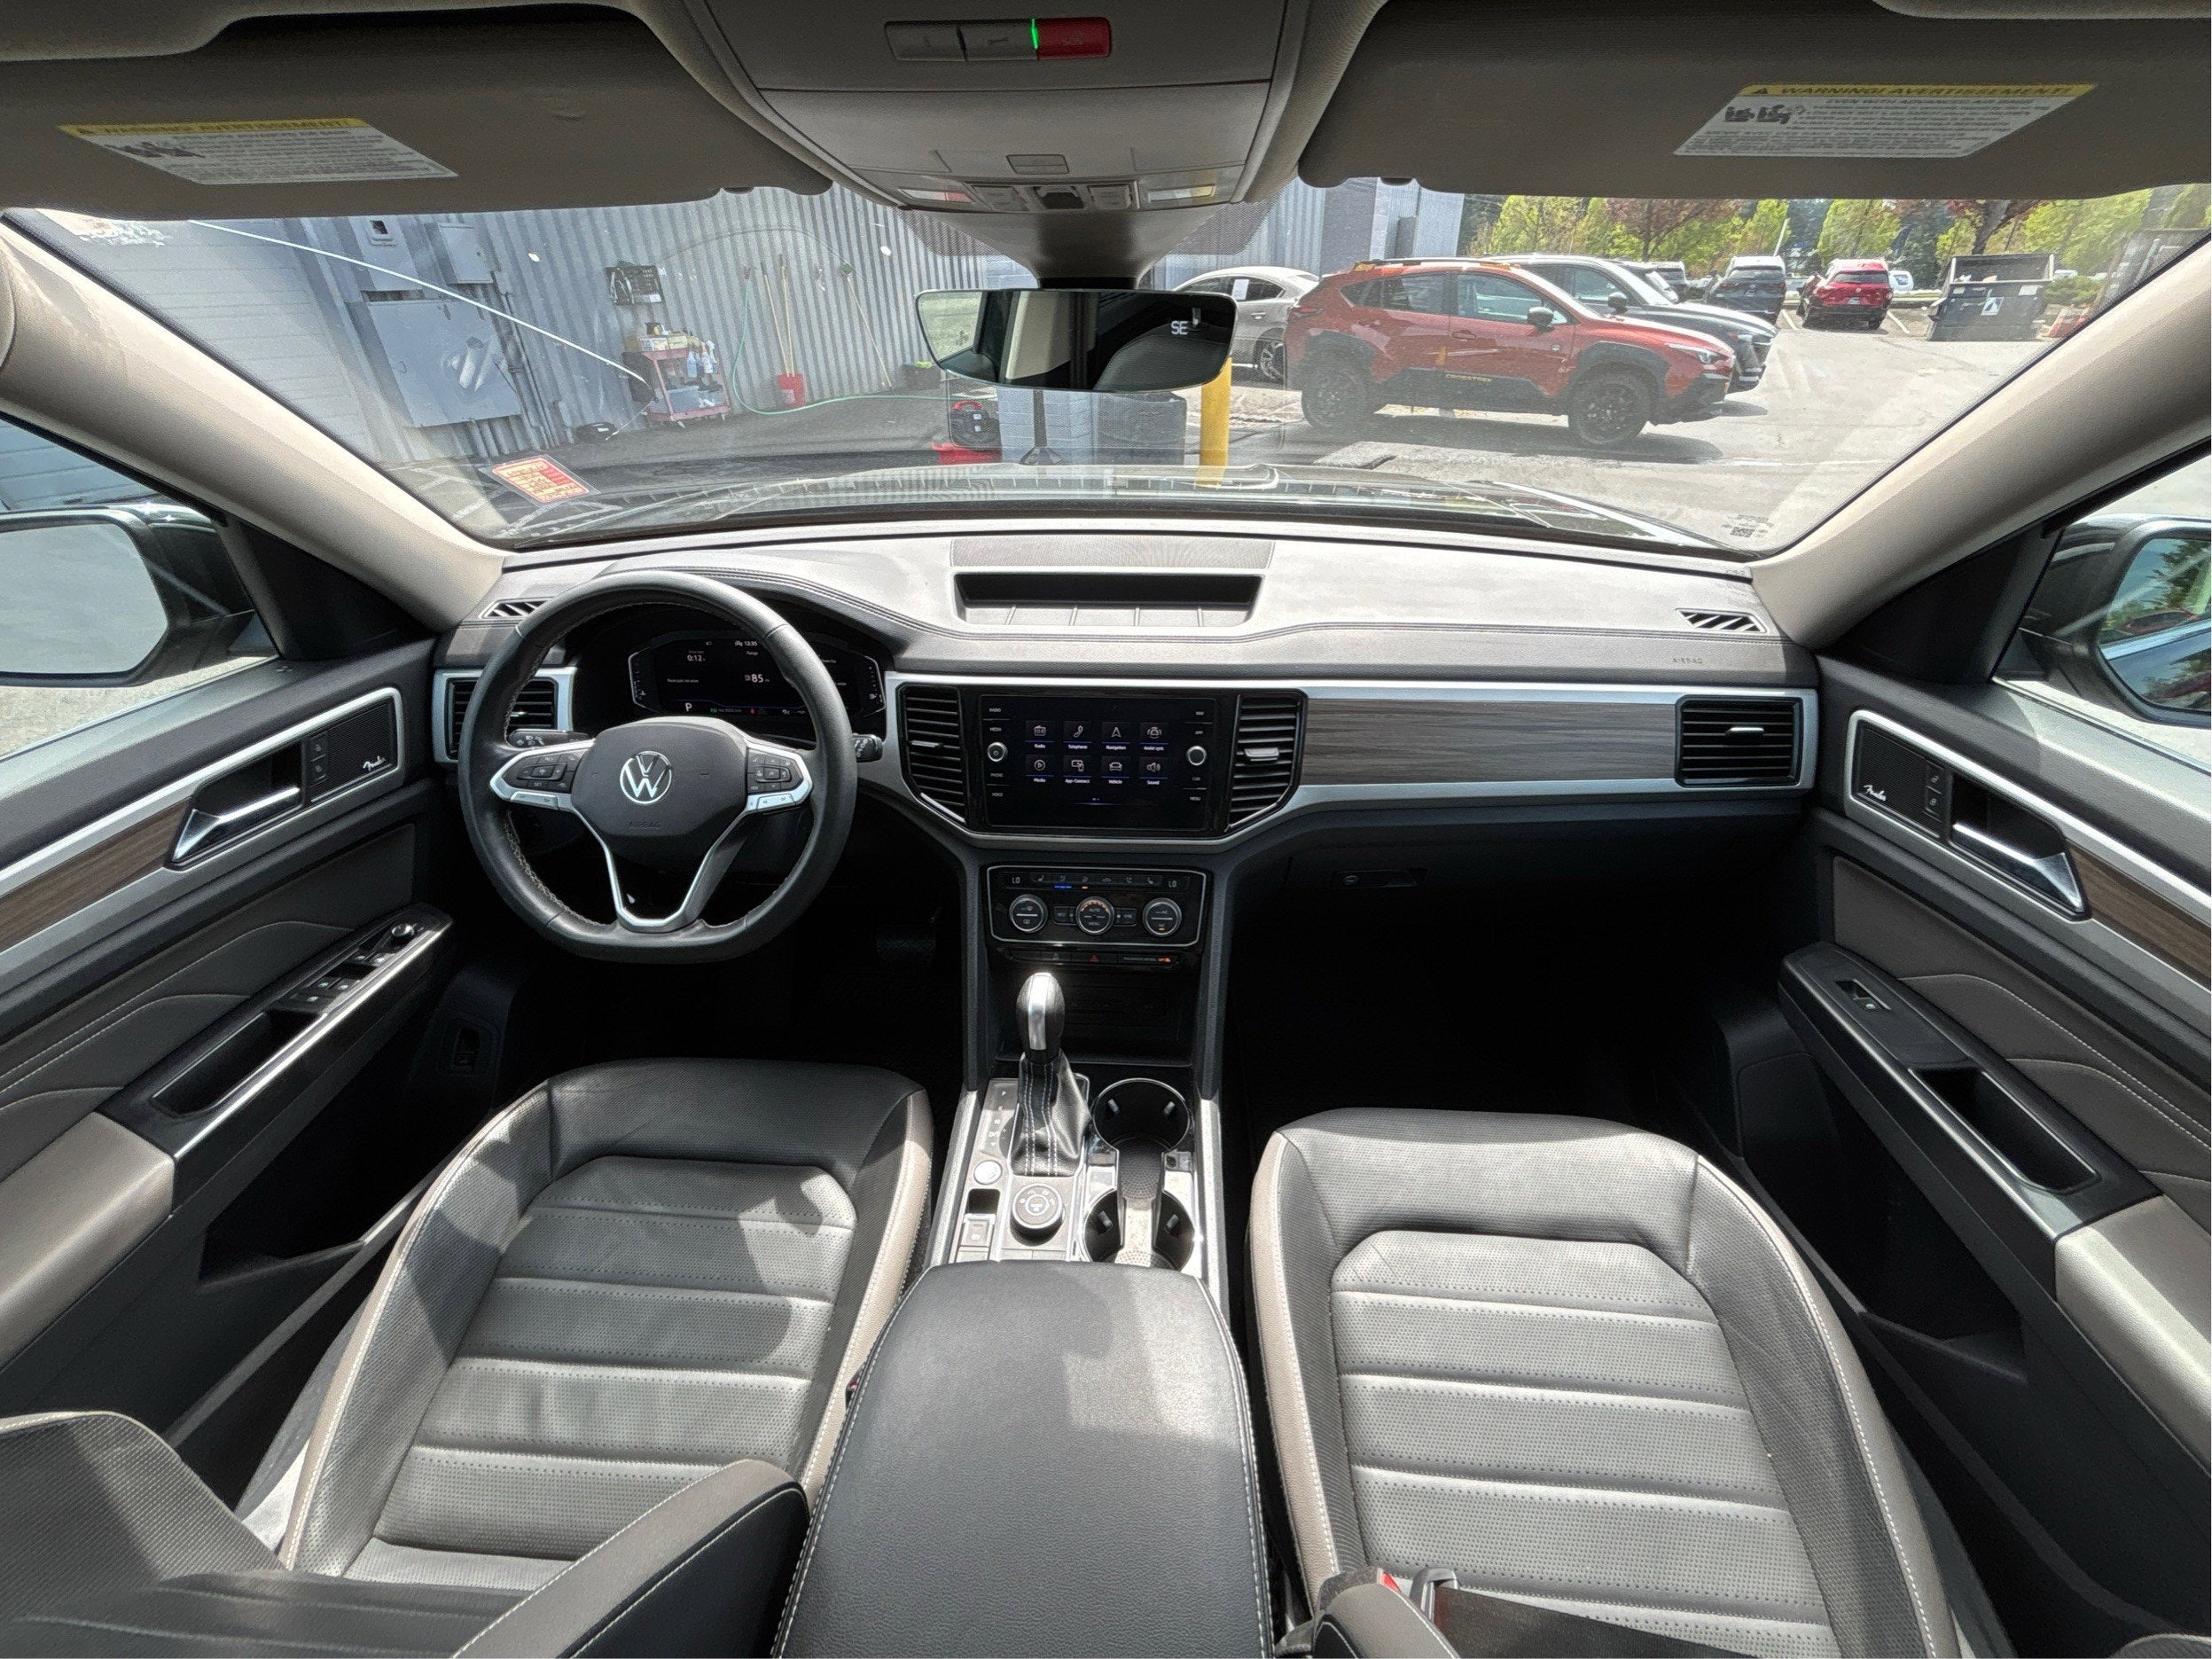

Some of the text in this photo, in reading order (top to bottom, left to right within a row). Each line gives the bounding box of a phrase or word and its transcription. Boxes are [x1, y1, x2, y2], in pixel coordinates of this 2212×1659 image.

[1170, 320, 1188, 335] SE
[1445, 373, 1493, 382] CROSSTREK
[751, 674, 763, 683] 85
[685, 702, 692, 712] P
